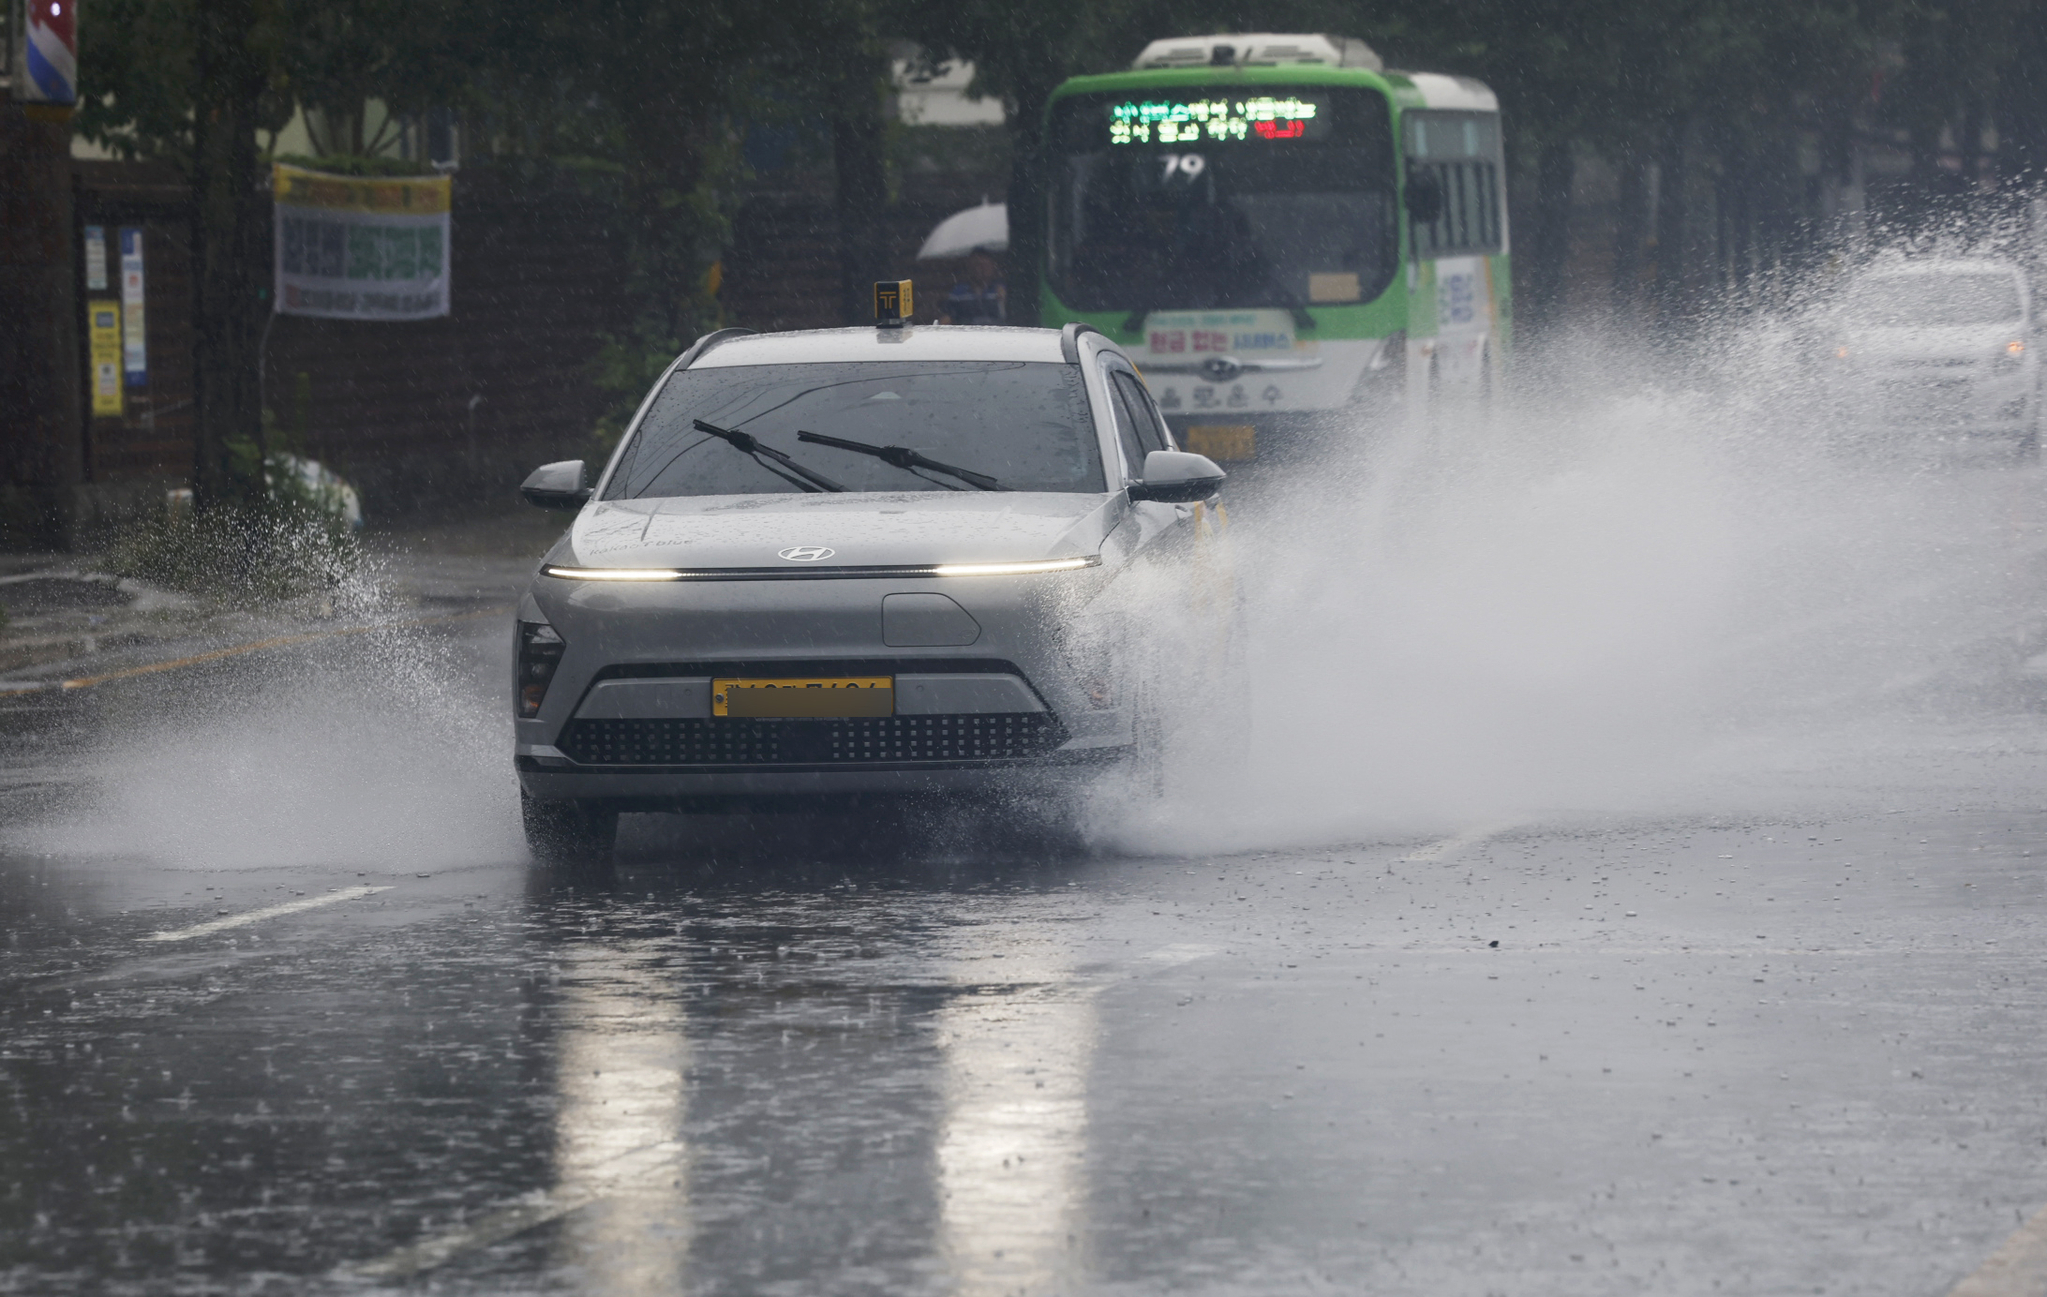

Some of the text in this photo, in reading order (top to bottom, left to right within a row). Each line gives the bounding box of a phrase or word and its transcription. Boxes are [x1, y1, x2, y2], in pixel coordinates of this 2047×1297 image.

[1150, 330, 1186, 354] 현금
[589, 543, 640, 556] kakao
[656, 539, 694, 547] blue
